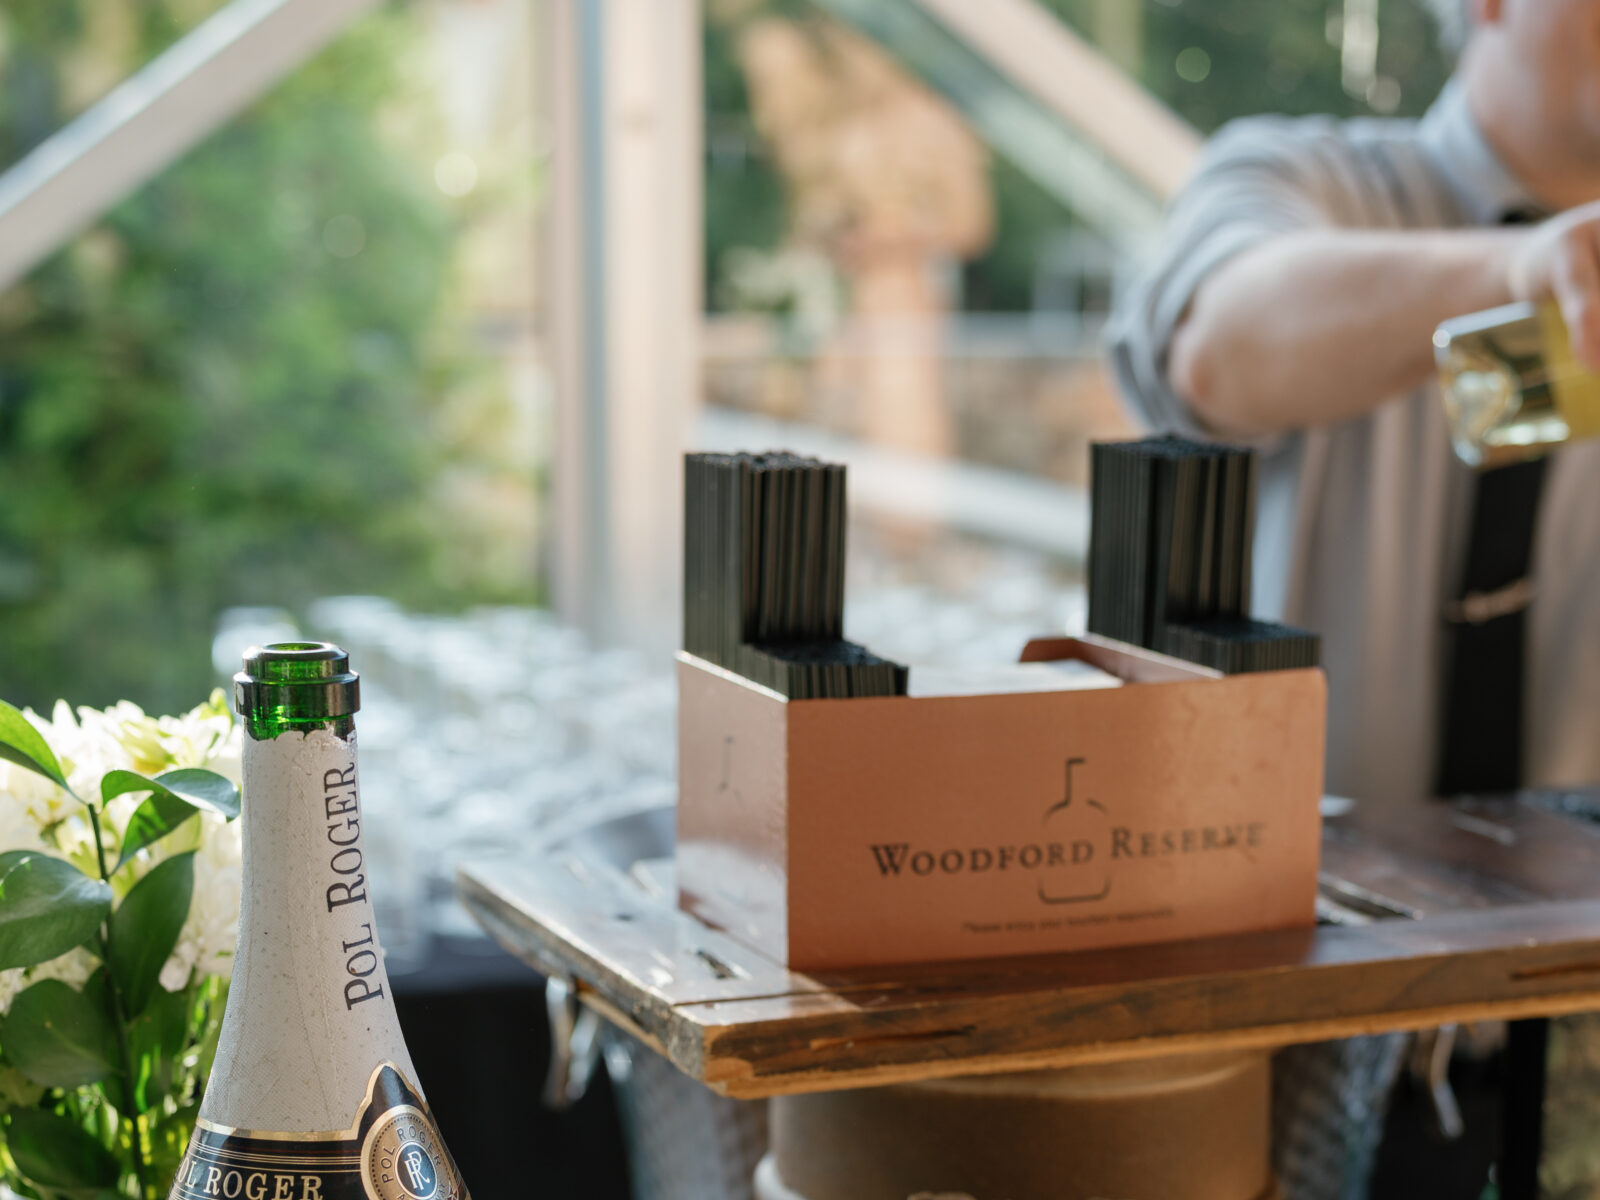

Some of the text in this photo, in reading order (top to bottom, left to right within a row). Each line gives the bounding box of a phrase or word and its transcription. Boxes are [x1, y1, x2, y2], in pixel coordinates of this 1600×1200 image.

[869, 822, 1267, 877] WOODFORD RESERVE
[323, 761, 384, 1011] POL ROGER
[176, 1156, 197, 1189] OL
[381, 1125, 442, 1184] POL ROGER
